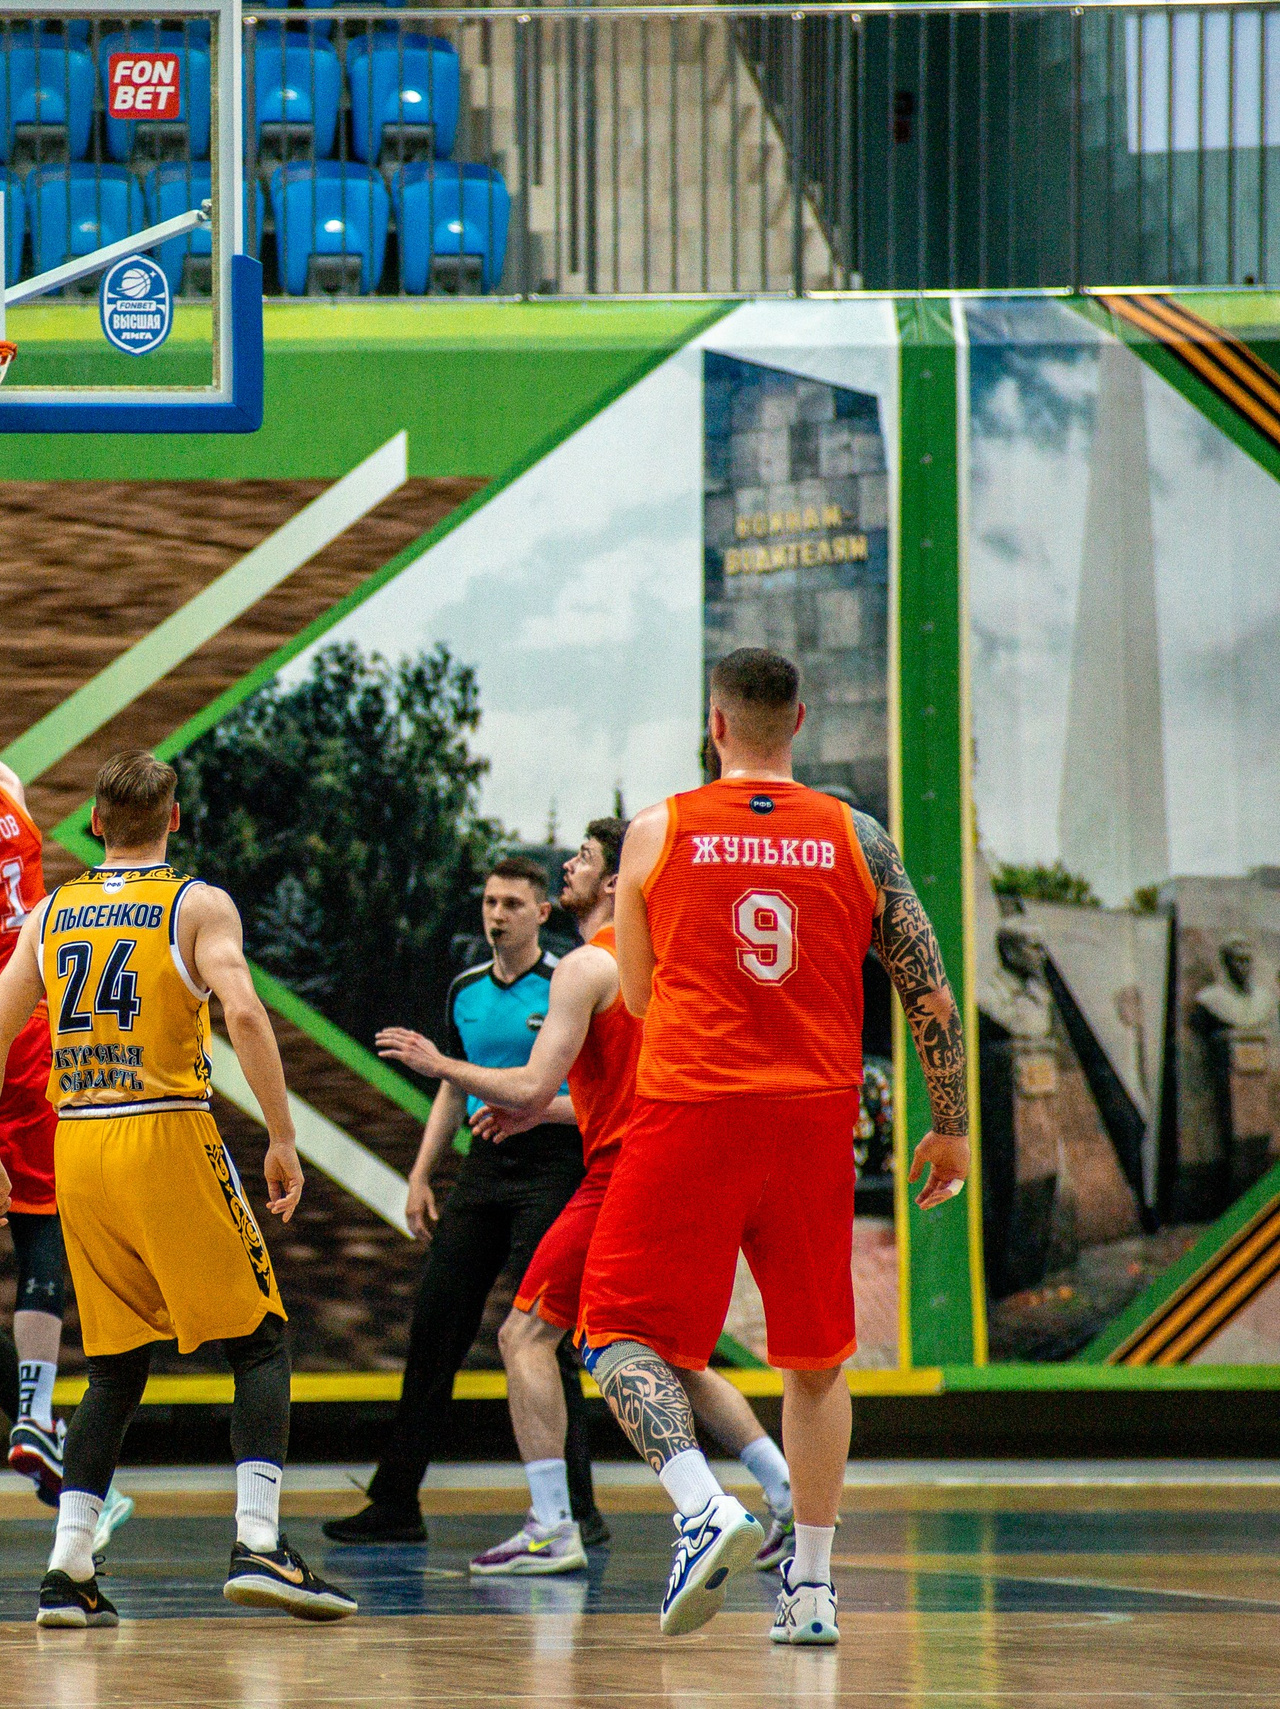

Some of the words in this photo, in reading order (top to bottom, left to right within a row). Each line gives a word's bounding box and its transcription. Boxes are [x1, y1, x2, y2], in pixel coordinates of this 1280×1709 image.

[113, 60, 175, 84] FON
[113, 85, 175, 110] BET
[113, 314, 160, 329] ВЫСШАЯ
[121, 331, 153, 340] ЛИГА
[692, 835, 836, 870] ЖУЛЬКОВ
[51, 903, 165, 935] ЛЫСЕНКОВ
[732, 887, 799, 987] 9
[57, 939, 142, 1035] 24
[54, 1043, 144, 1070] КУРСКАЯ
[58, 1068, 145, 1094] ОБЛАСТЬ
